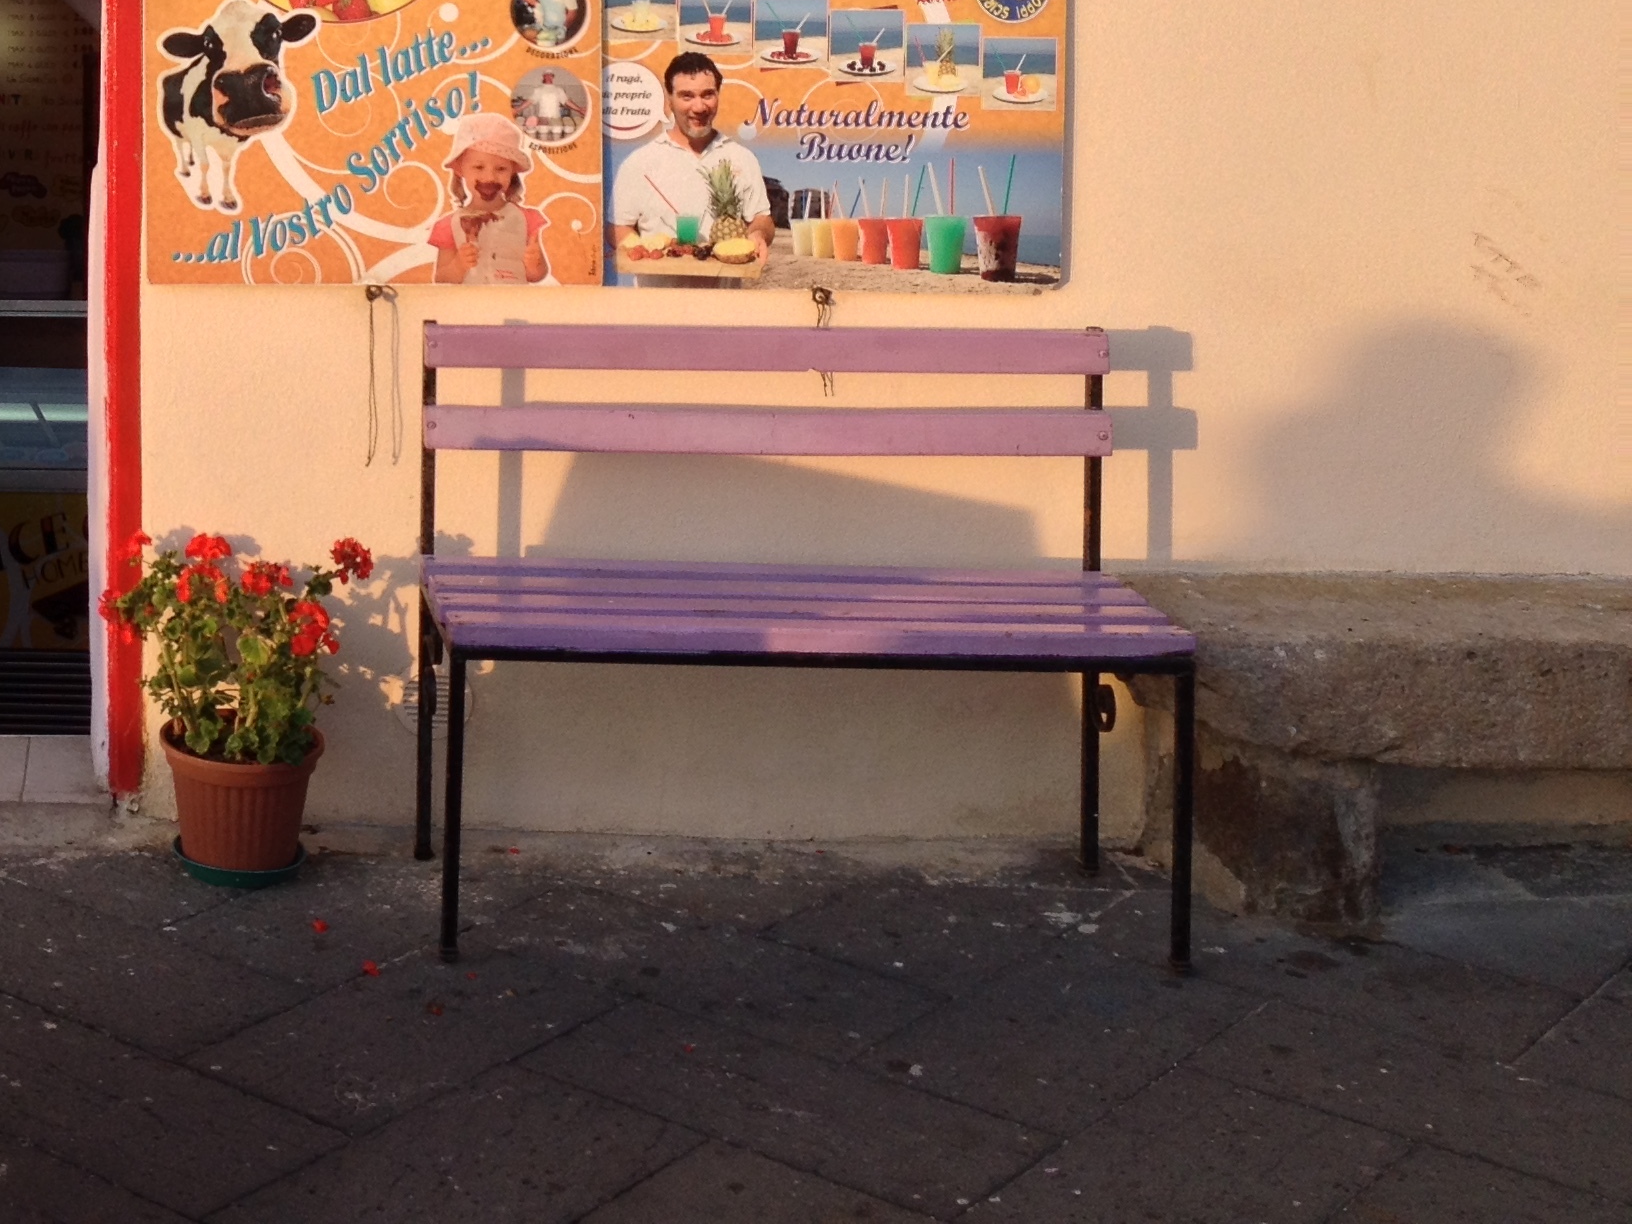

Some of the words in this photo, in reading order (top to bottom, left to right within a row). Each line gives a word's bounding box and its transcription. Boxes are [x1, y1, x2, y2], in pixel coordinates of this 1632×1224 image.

[311, 53, 370, 116] Dal
[378, 27, 493, 92] latte...
[347, 69, 484, 196] Sorriso!
[744, 98, 970, 131] Naturalmente
[795, 132, 914, 163] Buone!
[247, 184, 353, 256] Vostro
[21, 553, 87, 590] HOME
